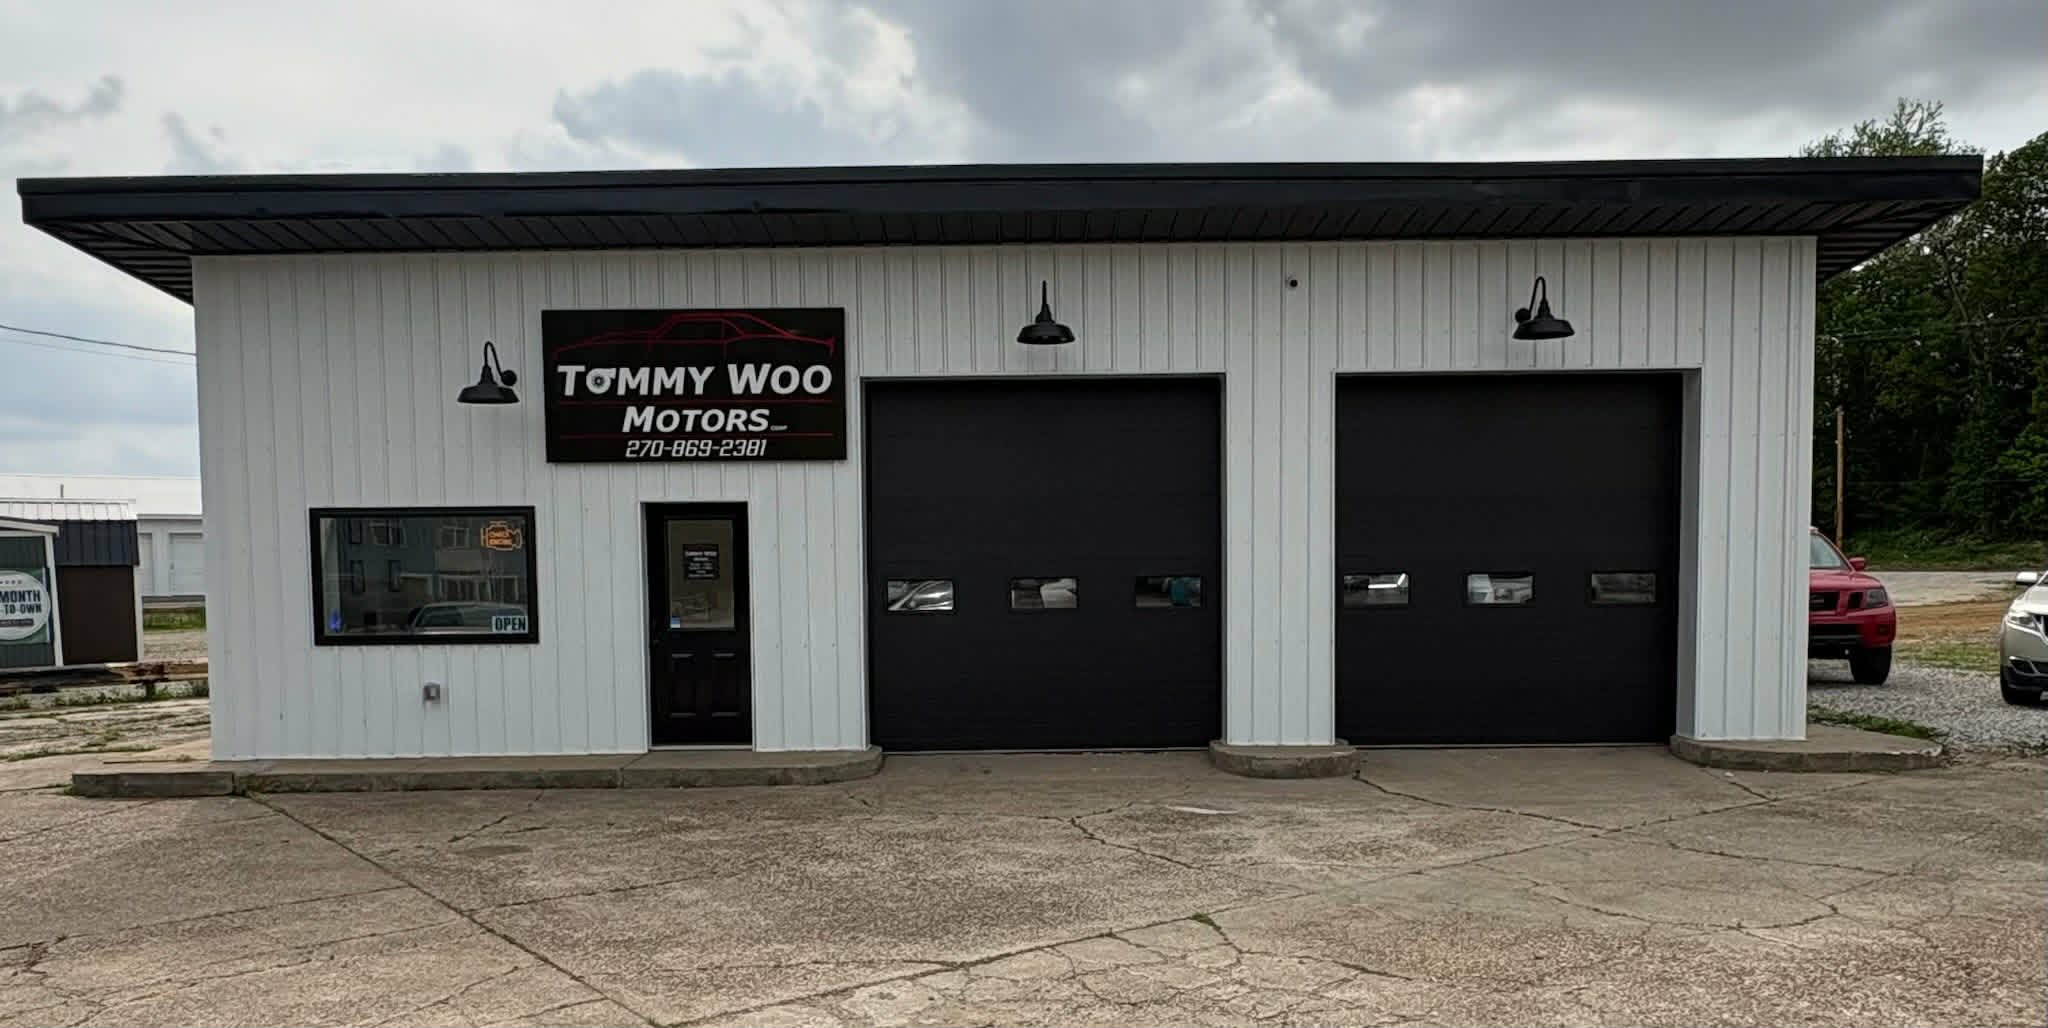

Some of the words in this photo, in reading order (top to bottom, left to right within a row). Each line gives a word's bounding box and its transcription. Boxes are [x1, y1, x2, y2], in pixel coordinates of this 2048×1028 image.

[557, 364, 715, 396] TOMMY
[727, 363, 833, 395] WOO
[622, 405, 770, 433] MOTORS
[625, 439, 767, 458] 270-869-2381
[495, 617, 526, 631] OPEN
